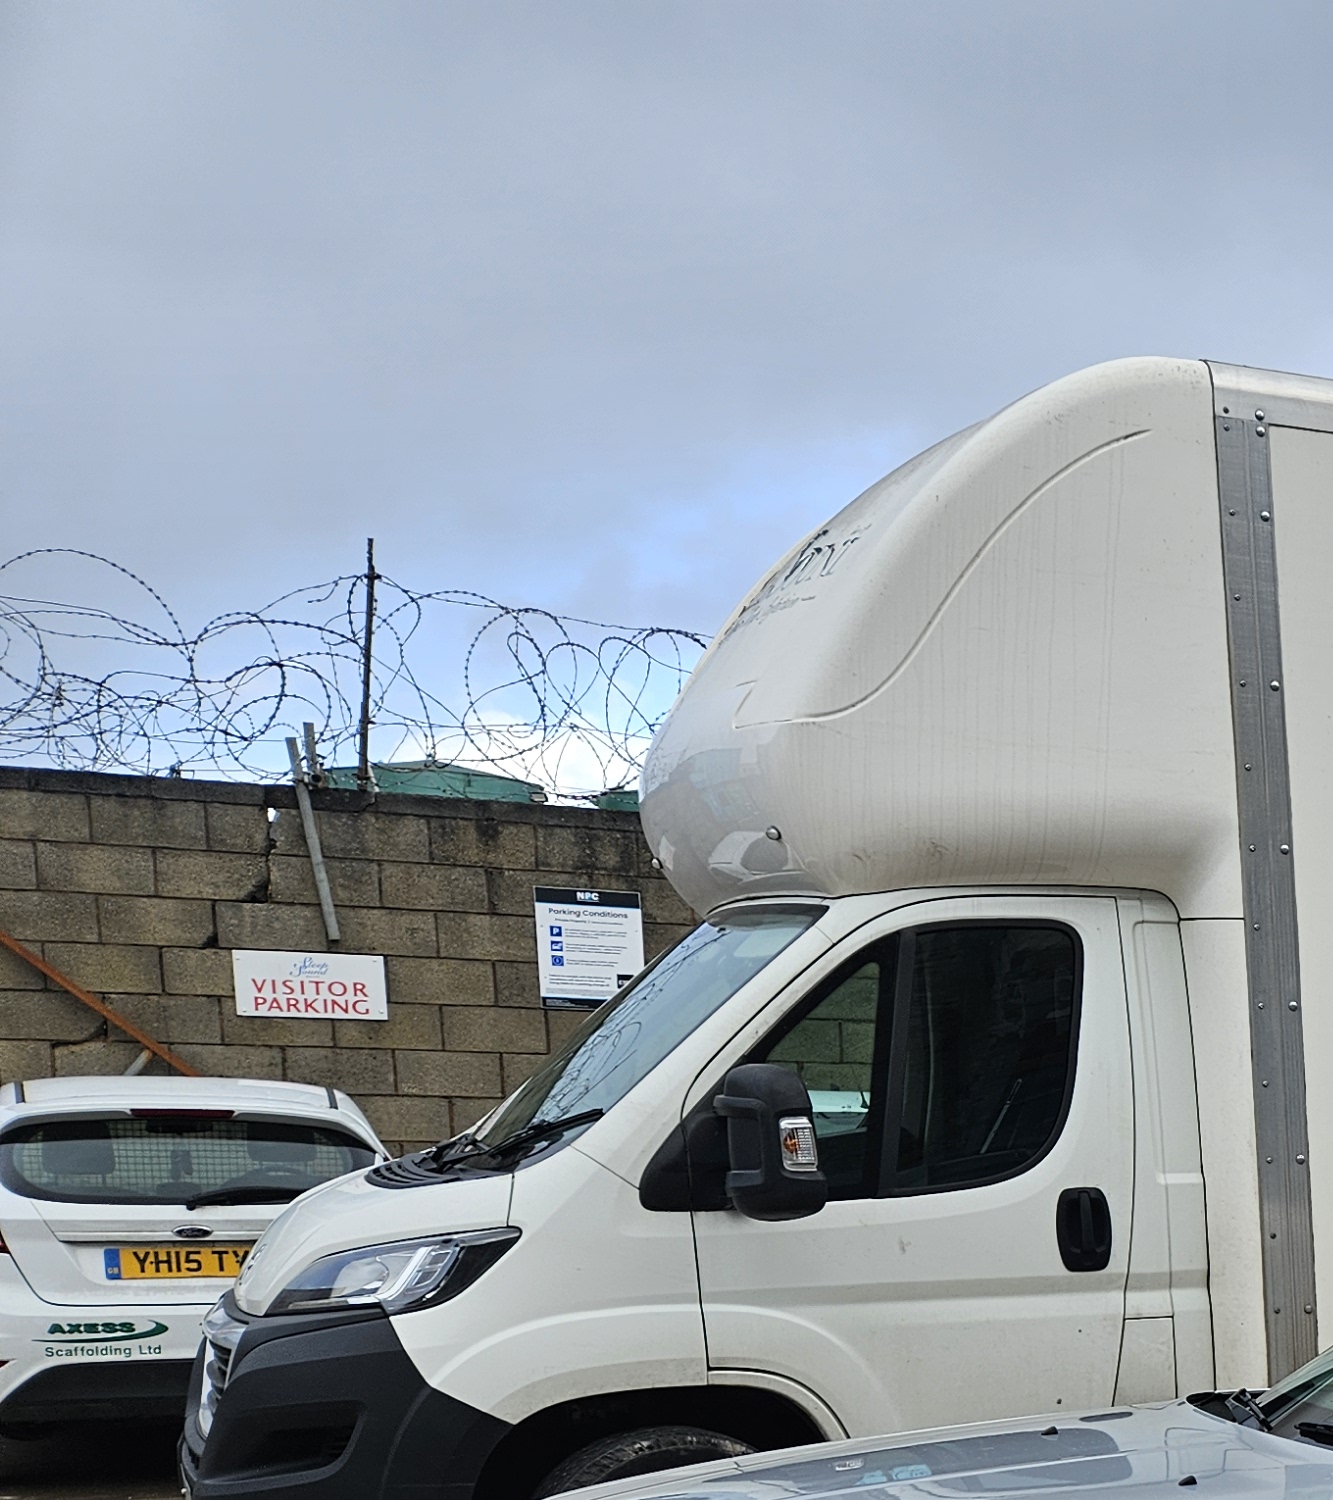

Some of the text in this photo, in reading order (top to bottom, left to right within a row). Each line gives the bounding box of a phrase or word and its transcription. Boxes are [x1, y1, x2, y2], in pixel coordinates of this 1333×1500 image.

[576, 891, 600, 902] NPC
[548, 907, 629, 919] Parking Conditions
[251, 978, 369, 998] VISITOR
[254, 996, 370, 1015] PARKING
[132, 1250, 203, 1273] YH15
[47, 1322, 136, 1335] AXESS
[45, 1345, 162, 1357] Scaffolding Ltd
